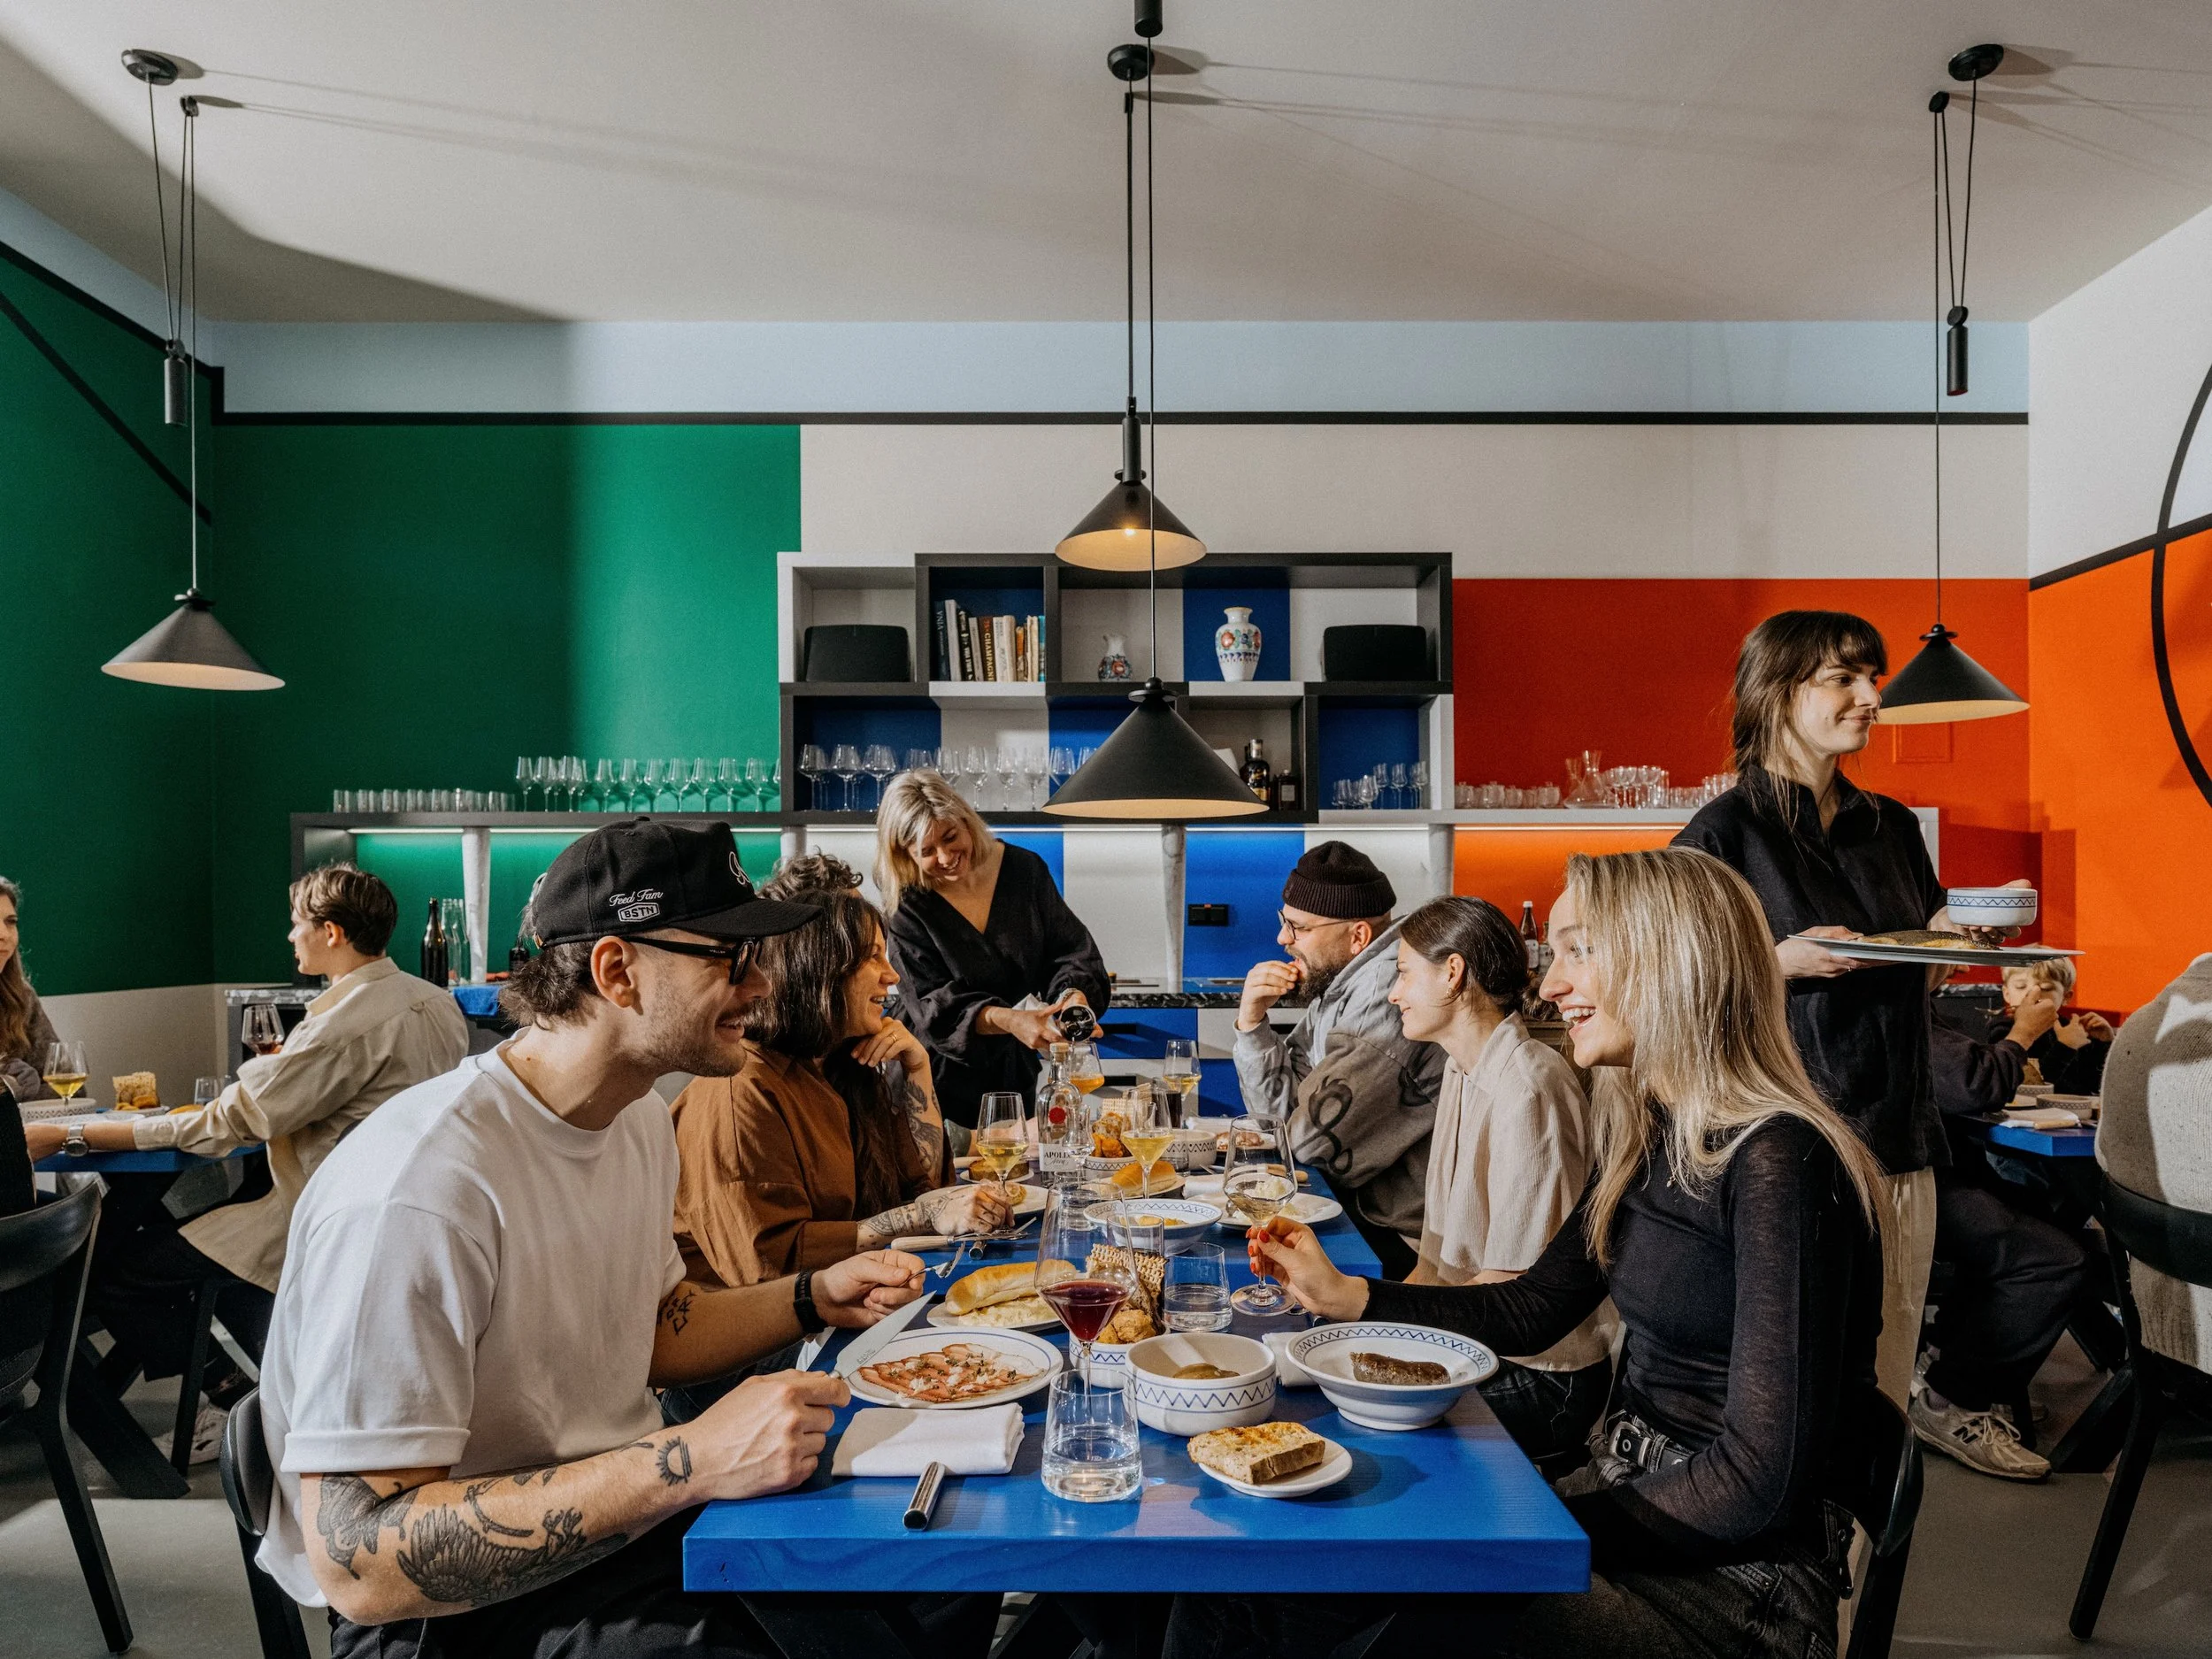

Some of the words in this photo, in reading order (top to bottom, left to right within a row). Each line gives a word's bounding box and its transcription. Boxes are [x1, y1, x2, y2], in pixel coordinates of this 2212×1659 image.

[609, 891, 636, 907] Feed
[636, 888, 664, 901] Fam
[624, 906, 654, 918] BSTN
